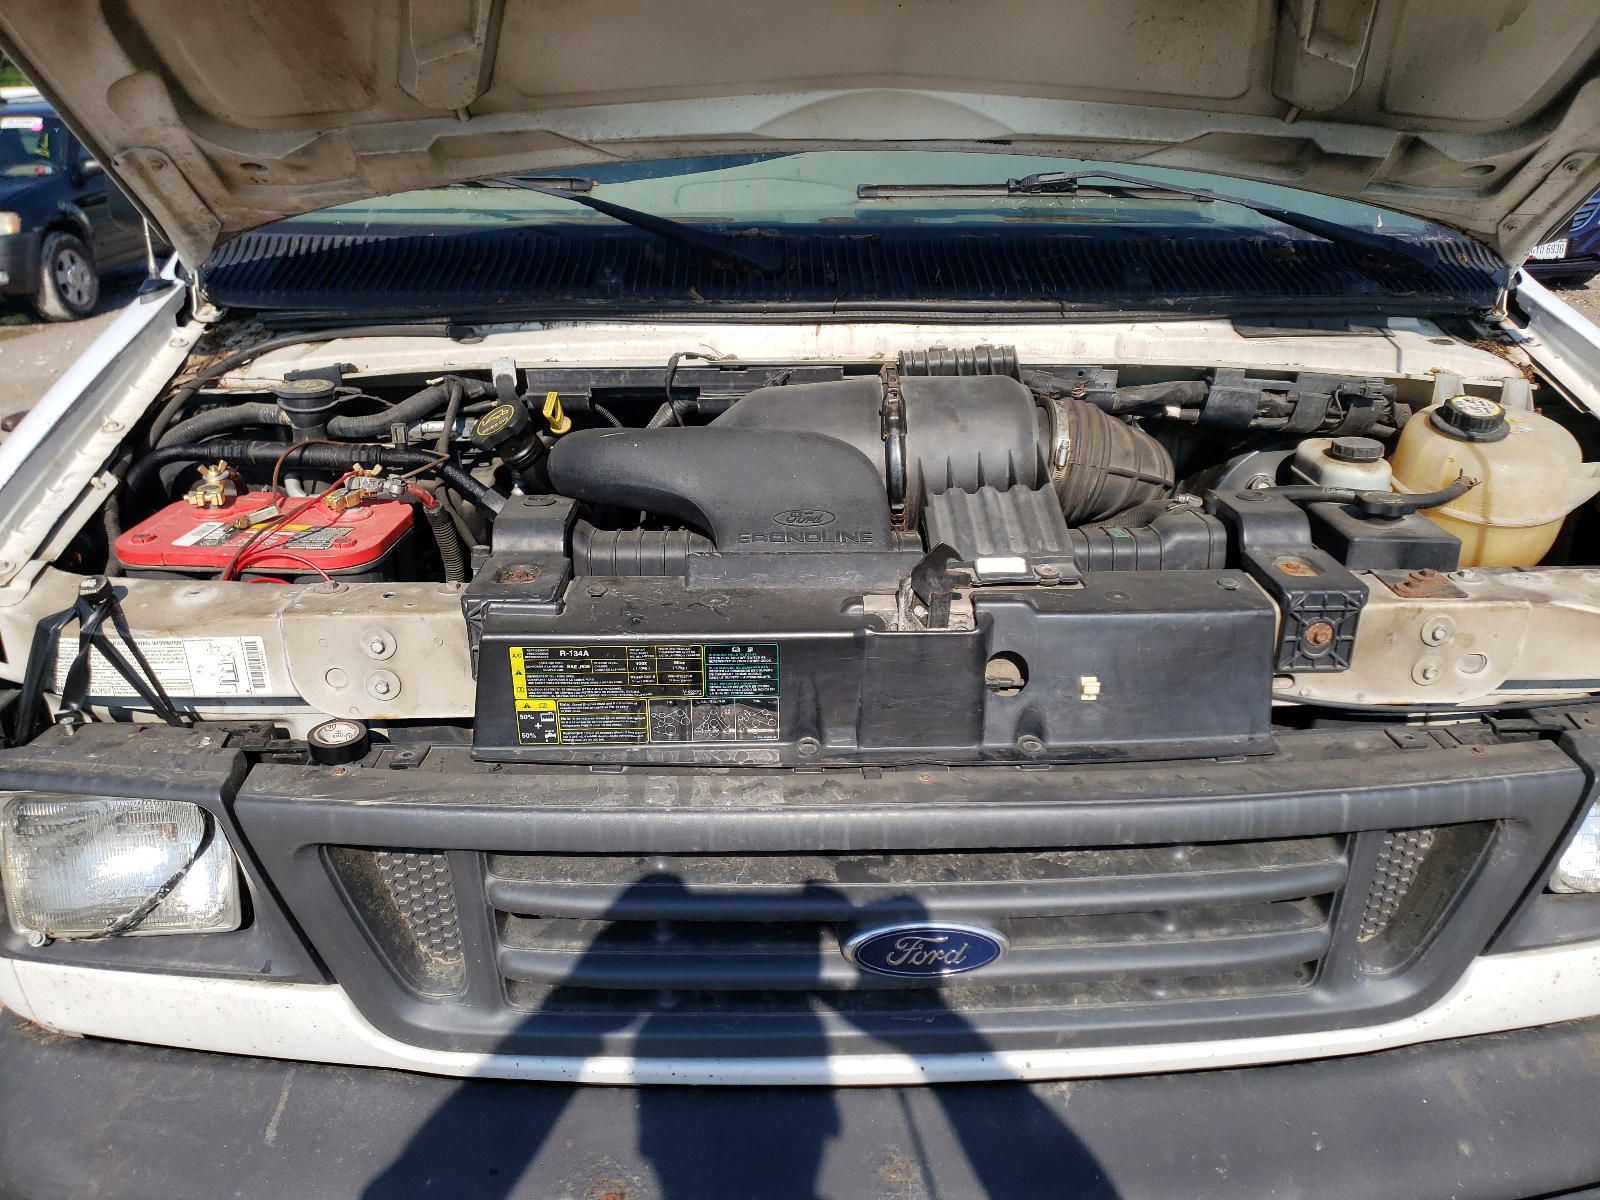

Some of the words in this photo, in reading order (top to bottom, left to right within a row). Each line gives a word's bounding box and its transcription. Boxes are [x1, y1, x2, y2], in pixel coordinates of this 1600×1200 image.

[785, 510, 824, 523] Ford
[737, 531, 874, 544] ECONOLINE
[886, 936, 968, 966] Ford
